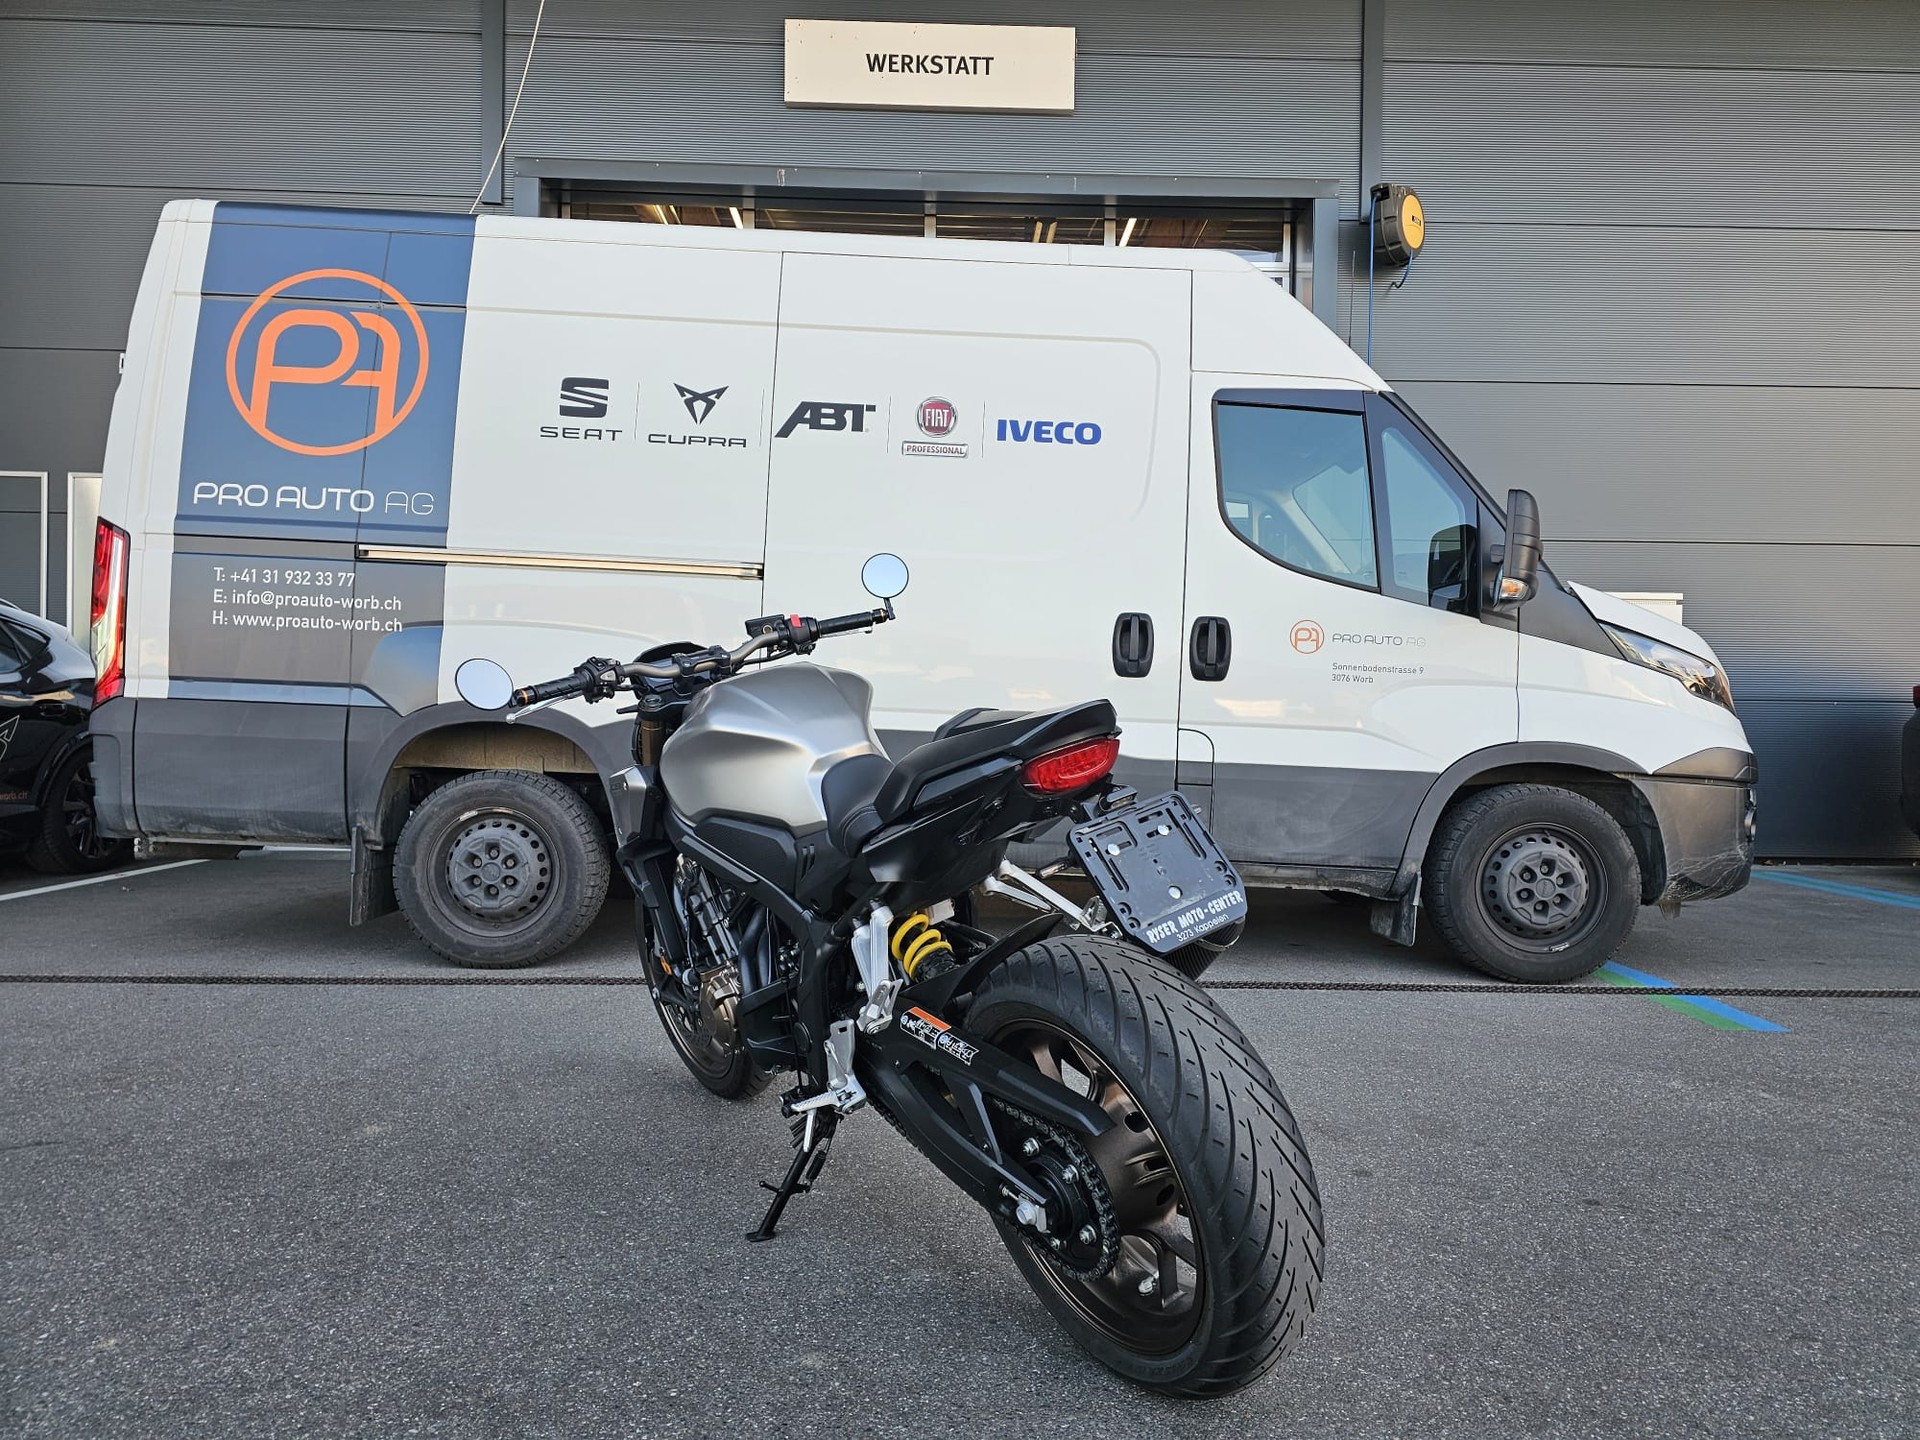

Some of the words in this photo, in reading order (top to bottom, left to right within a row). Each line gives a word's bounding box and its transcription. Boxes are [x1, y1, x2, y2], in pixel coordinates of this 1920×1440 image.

[865, 53, 994, 75] WERKSTATT
[774, 400, 876, 438] ABT
[925, 408, 949, 427] FIAT
[540, 426, 622, 441] SEAT
[648, 433, 747, 448] CUPRA
[996, 419, 1101, 445] IVECO
[906, 444, 964, 455] PROFESSIONAL
[193, 482, 268, 507] PRO
[276, 485, 375, 513] AUTO
[384, 490, 434, 515] AG
[213, 567, 226, 582] T:
[230, 568, 257, 583] +41
[262, 569, 278, 584] 31
[285, 570, 311, 586] 932
[315, 571, 333, 587] 33
[337, 572, 355, 587] 77
[213, 589, 227, 604] E:
[232, 589, 402, 611] info@proauto-worb.ch
[212, 610, 228, 626] H:
[232, 613, 403, 632] www.proauto-worb.ch
[1332, 633, 1362, 644] PRO
[1363, 634, 1403, 646] AUTO
[1406, 636, 1426, 647] AG
[1332, 662, 1417, 673] Sonnenbodenstrasse
[1332, 674, 1351, 682] 3076
[1353, 675, 1374, 683] Worb
[1146, 920, 1178, 943] RYSER
[1177, 890, 1244, 928] MOTO-CENTER
[1177, 928, 1195, 942] 3273
[1194, 913, 1230, 934] Kappelen
